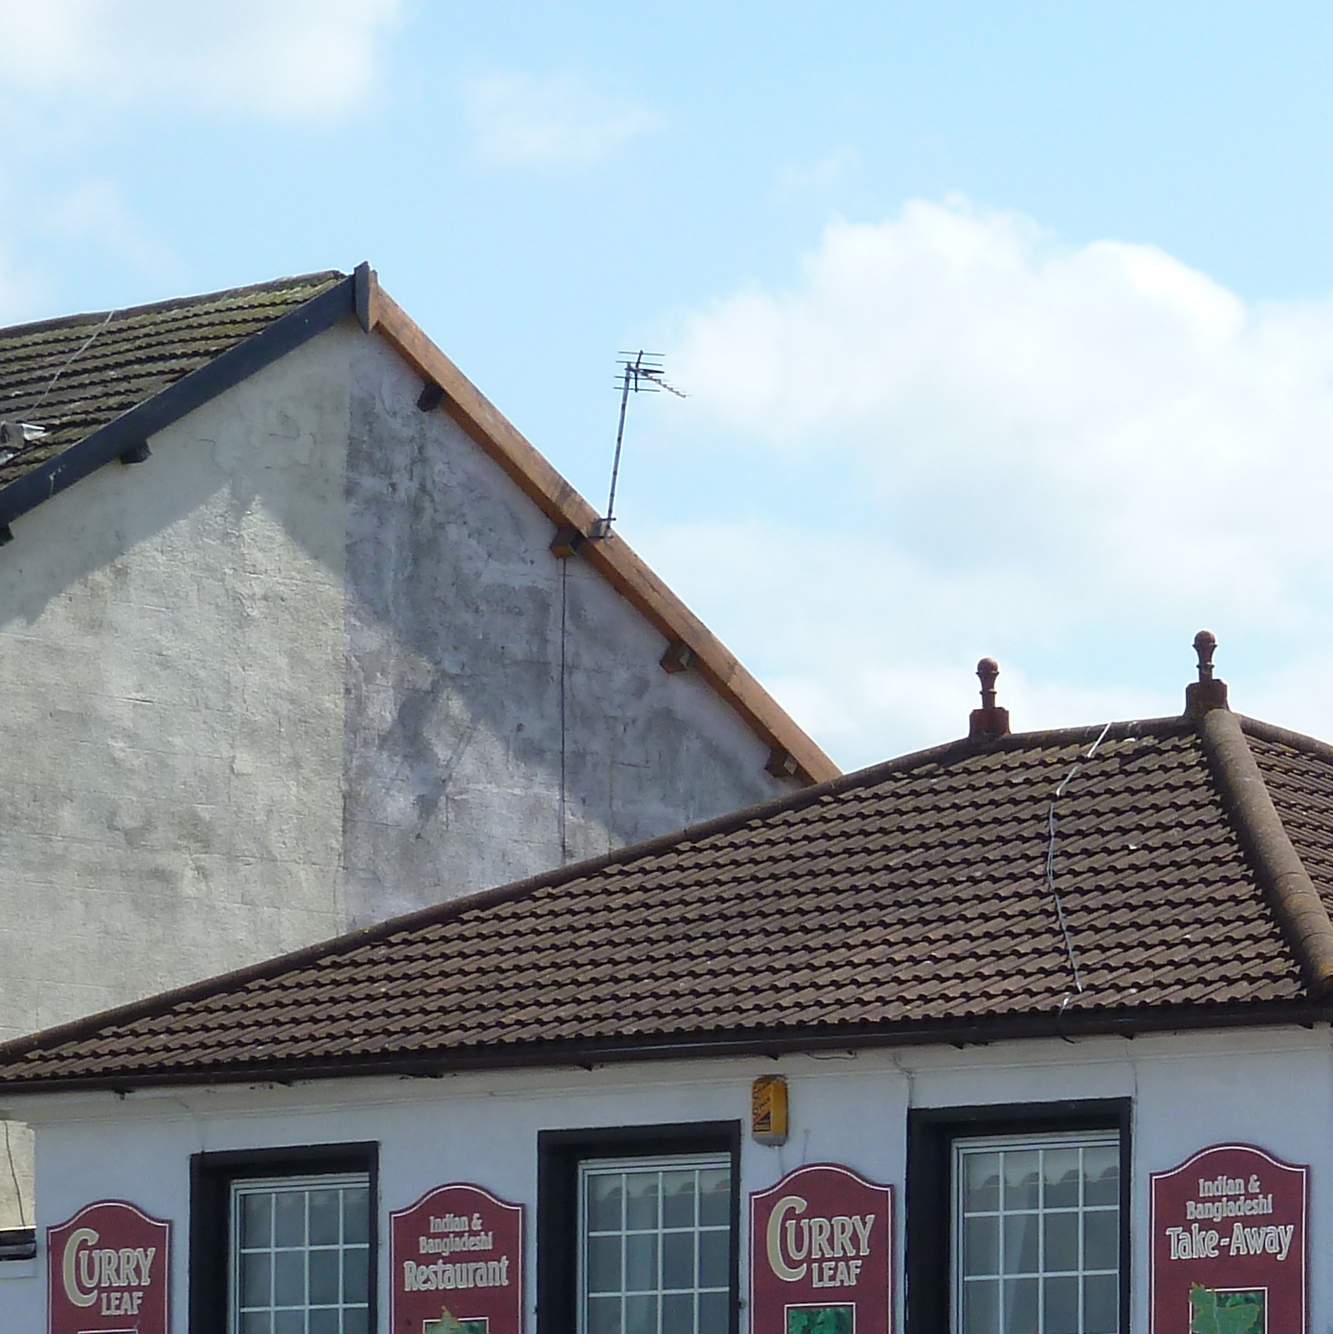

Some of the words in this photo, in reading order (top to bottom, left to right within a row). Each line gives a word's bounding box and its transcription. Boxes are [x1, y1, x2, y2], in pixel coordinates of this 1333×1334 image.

[1199, 1175, 1245, 1197] Indian
[1248, 1174, 1260, 1193] &
[1186, 1194, 1273, 1222] Bangladeshi
[429, 1213, 469, 1233] Indian
[471, 1213, 482, 1230] &
[419, 1231, 493, 1256] Bangladeshi
[766, 1195, 876, 1282] CURRY
[1165, 1222, 1295, 1261] Take-Away
[63, 1228, 157, 1307] CURRY
[403, 1255, 509, 1291] Restaurant
[812, 1260, 862, 1288] LEAF
[101, 1291, 143, 1315] LEAF
